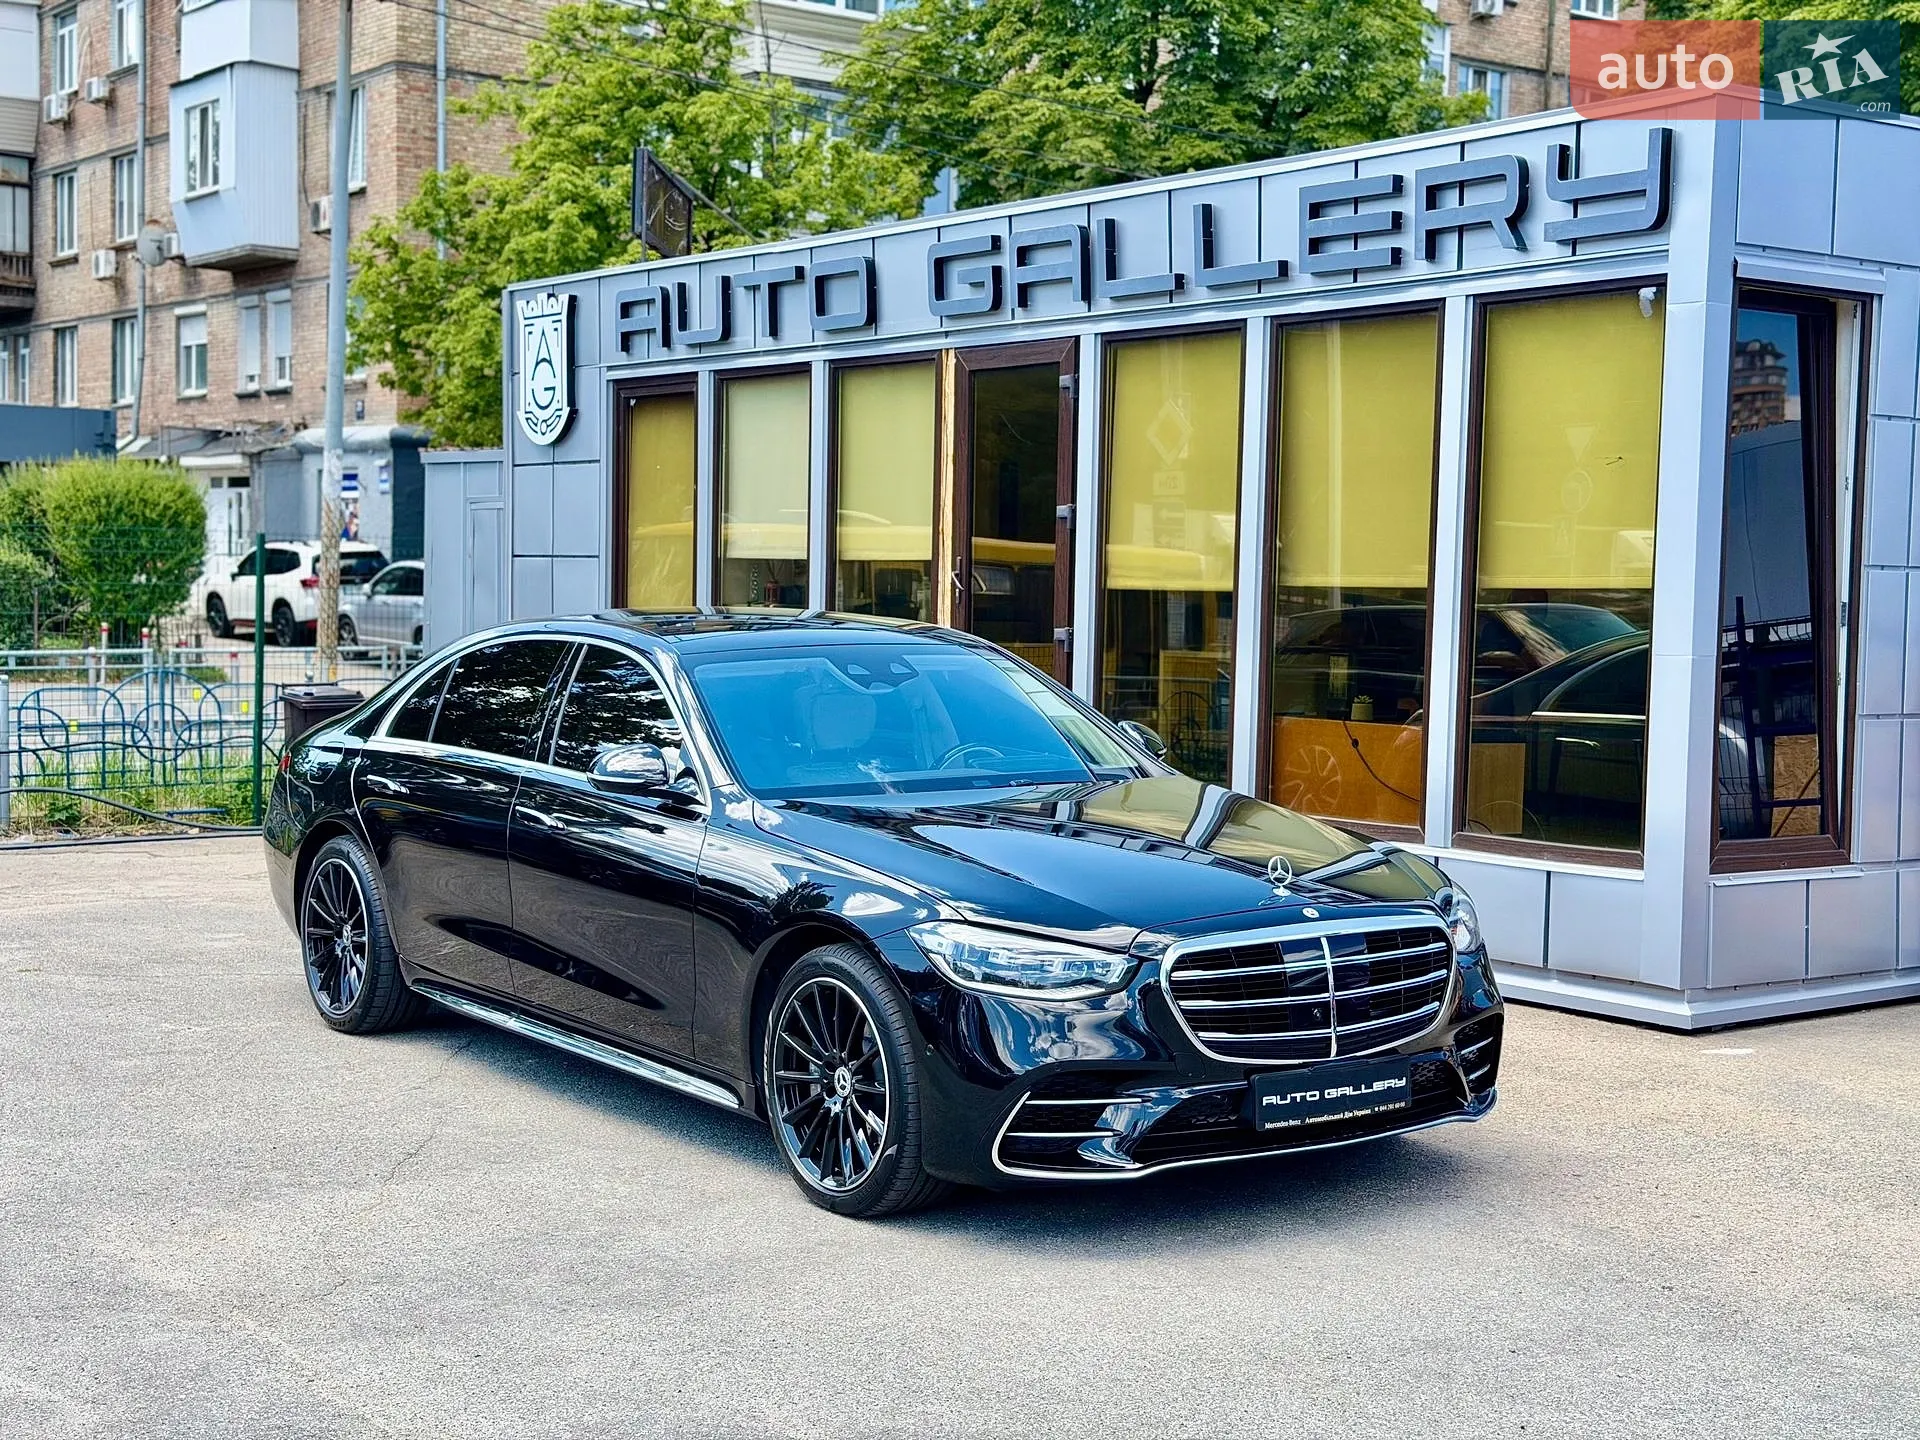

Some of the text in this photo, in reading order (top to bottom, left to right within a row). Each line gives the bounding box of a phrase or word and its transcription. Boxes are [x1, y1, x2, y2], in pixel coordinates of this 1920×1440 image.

[615, 127, 1675, 353] AUTO GALLERY
[1262, 1076, 1407, 1106] AUTO GALLERY
